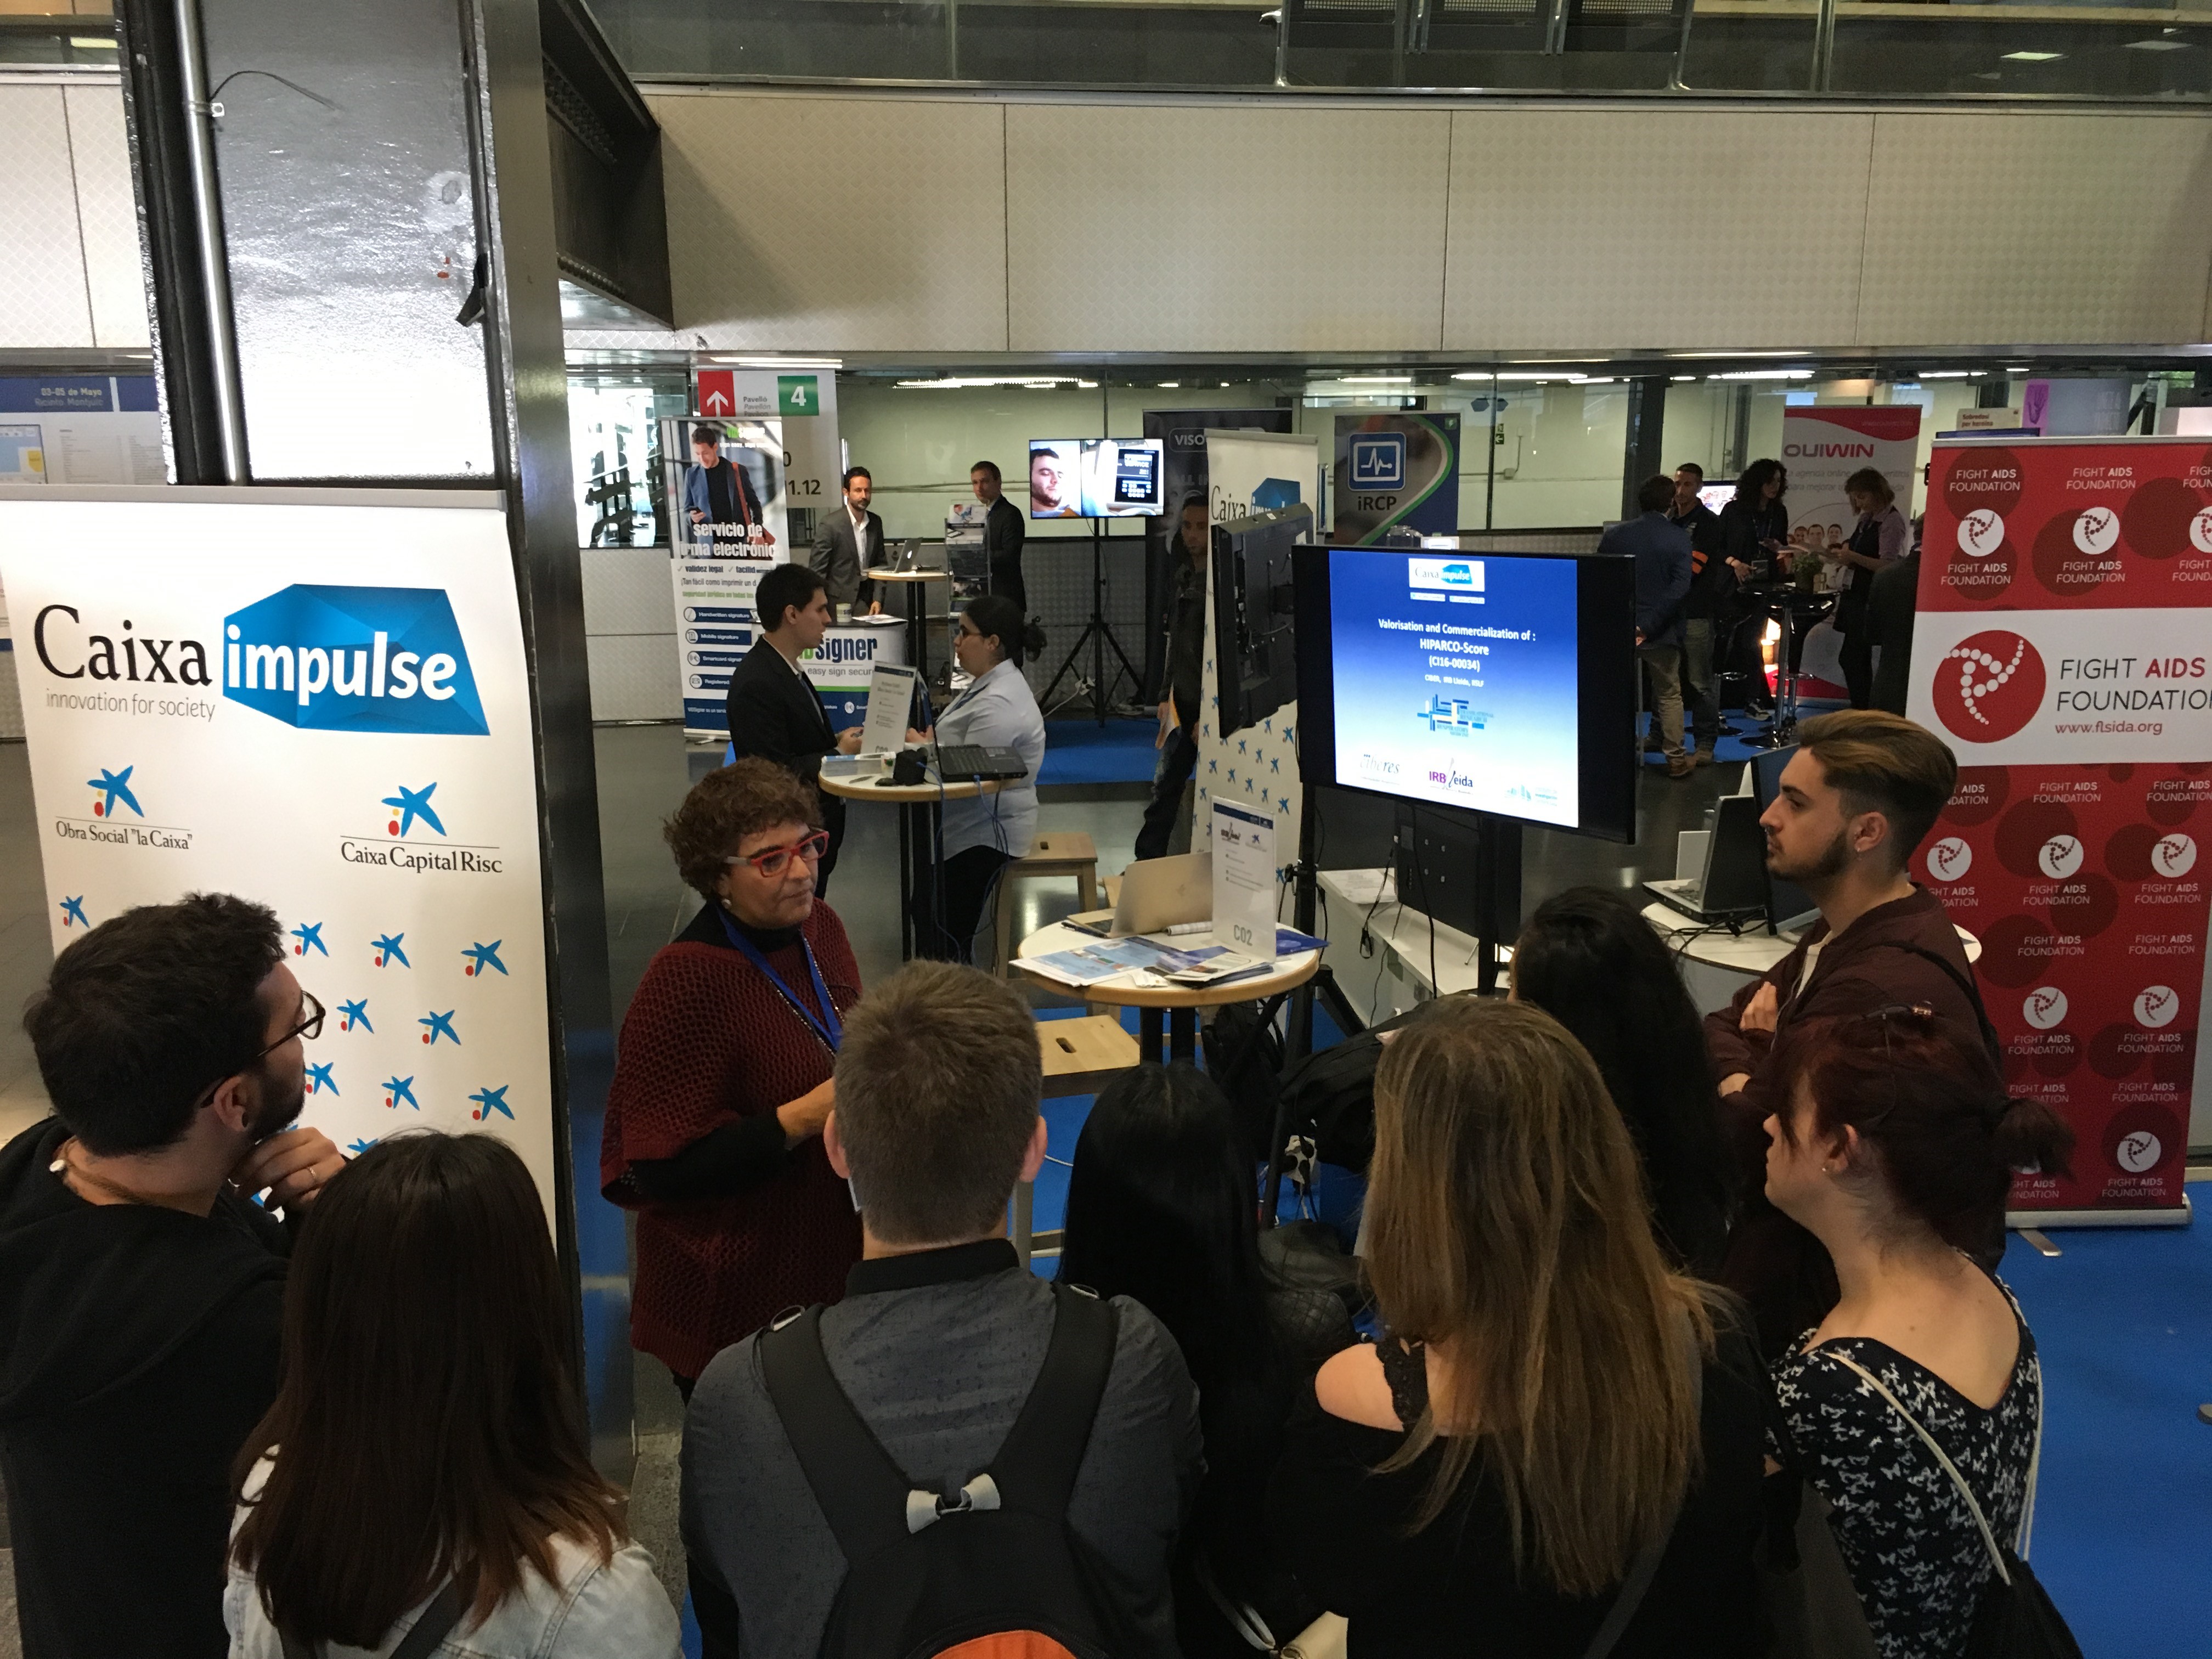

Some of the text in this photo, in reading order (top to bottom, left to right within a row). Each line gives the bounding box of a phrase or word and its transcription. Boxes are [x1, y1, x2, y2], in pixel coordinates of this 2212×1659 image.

[68, 388, 78, 396] de
[81, 387, 102, 397] Mayo
[791, 386, 807, 407] 4
[1956, 469, 2017, 479] FIGHT AIDS
[2073, 467, 2133, 478] FIGHT AIDS
[1949, 481, 2021, 492] FOUNDATION
[2066, 479, 2136, 490] FOUNDATION
[1211, 485, 1246, 521] Caixa
[1357, 496, 1397, 511] iRCP
[693, 522, 763, 537] servicio de
[1947, 563, 2008, 573] FIGHT AIDS
[2062, 561, 2123, 572] FIGHT AIDS
[2179, 560, 2211, 569] FIGHT
[1414, 566, 1471, 582] Caixa impulse
[2056, 573, 2126, 583] FOUNDATION
[1940, 574, 2011, 586] FOUNDATION
[1378, 618, 1424, 632] Valorisation
[1425, 623, 1441, 633] and
[1442, 623, 1519, 640] Commercialization
[1521, 630, 1531, 641] of
[1420, 638, 1489, 656] HIPARCO-Score
[33, 603, 457, 706] Caixa impulse
[1429, 655, 1481, 673] (CI16-00034)
[2060, 657, 2206, 680] FIGHT AIDS
[808, 667, 826, 676] easy
[828, 667, 846, 677] sign
[46, 688, 216, 723] innovation for society
[2056, 689, 2212, 712] FOUNDATIO
[2055, 720, 2163, 735] www.flsida.org
[1429, 770, 1447, 784] IRB
[1961, 784, 1985, 793] AIDS
[2040, 781, 2098, 792] FIGHT AIDS
[2153, 780, 2211, 790] FIGHT AIDS
[2033, 792, 2102, 803] FOUNDATION
[55, 820, 87, 840] Obra
[89, 825, 129, 844] Social
[1951, 887, 1976, 896] AIDS
[2029, 884, 2087, 895] FIGHT AIDS
[2141, 883, 2199, 893] FIGHT AIDS
[2023, 894, 2090, 906] FOUNDATION
[2134, 893, 2202, 904] FOUNDATION
[2024, 935, 2081, 946] FIGHT AIDS
[2135, 934, 2193, 944] FIGHT AIDS
[2017, 945, 2085, 957] FOUNDATION
[2128, 944, 2196, 955] FOUNDATION
[2013, 1034, 2072, 1044] FIGHT AIDS
[2124, 1033, 2181, 1043] FIGHT AIDS
[2007, 1045, 2075, 1056] FOUNDATION
[2117, 1043, 2184, 1054] FOUNDATION
[2009, 1084, 2066, 1093] FIGHT AIDS
[2118, 1082, 2176, 1093] FIGHT AIDS
[2112, 1092, 2179, 1103] FOUNDATION
[2108, 1178, 2163, 1188] FIGHT AIDS
[2101, 1187, 2166, 1198] FOUNDATION
